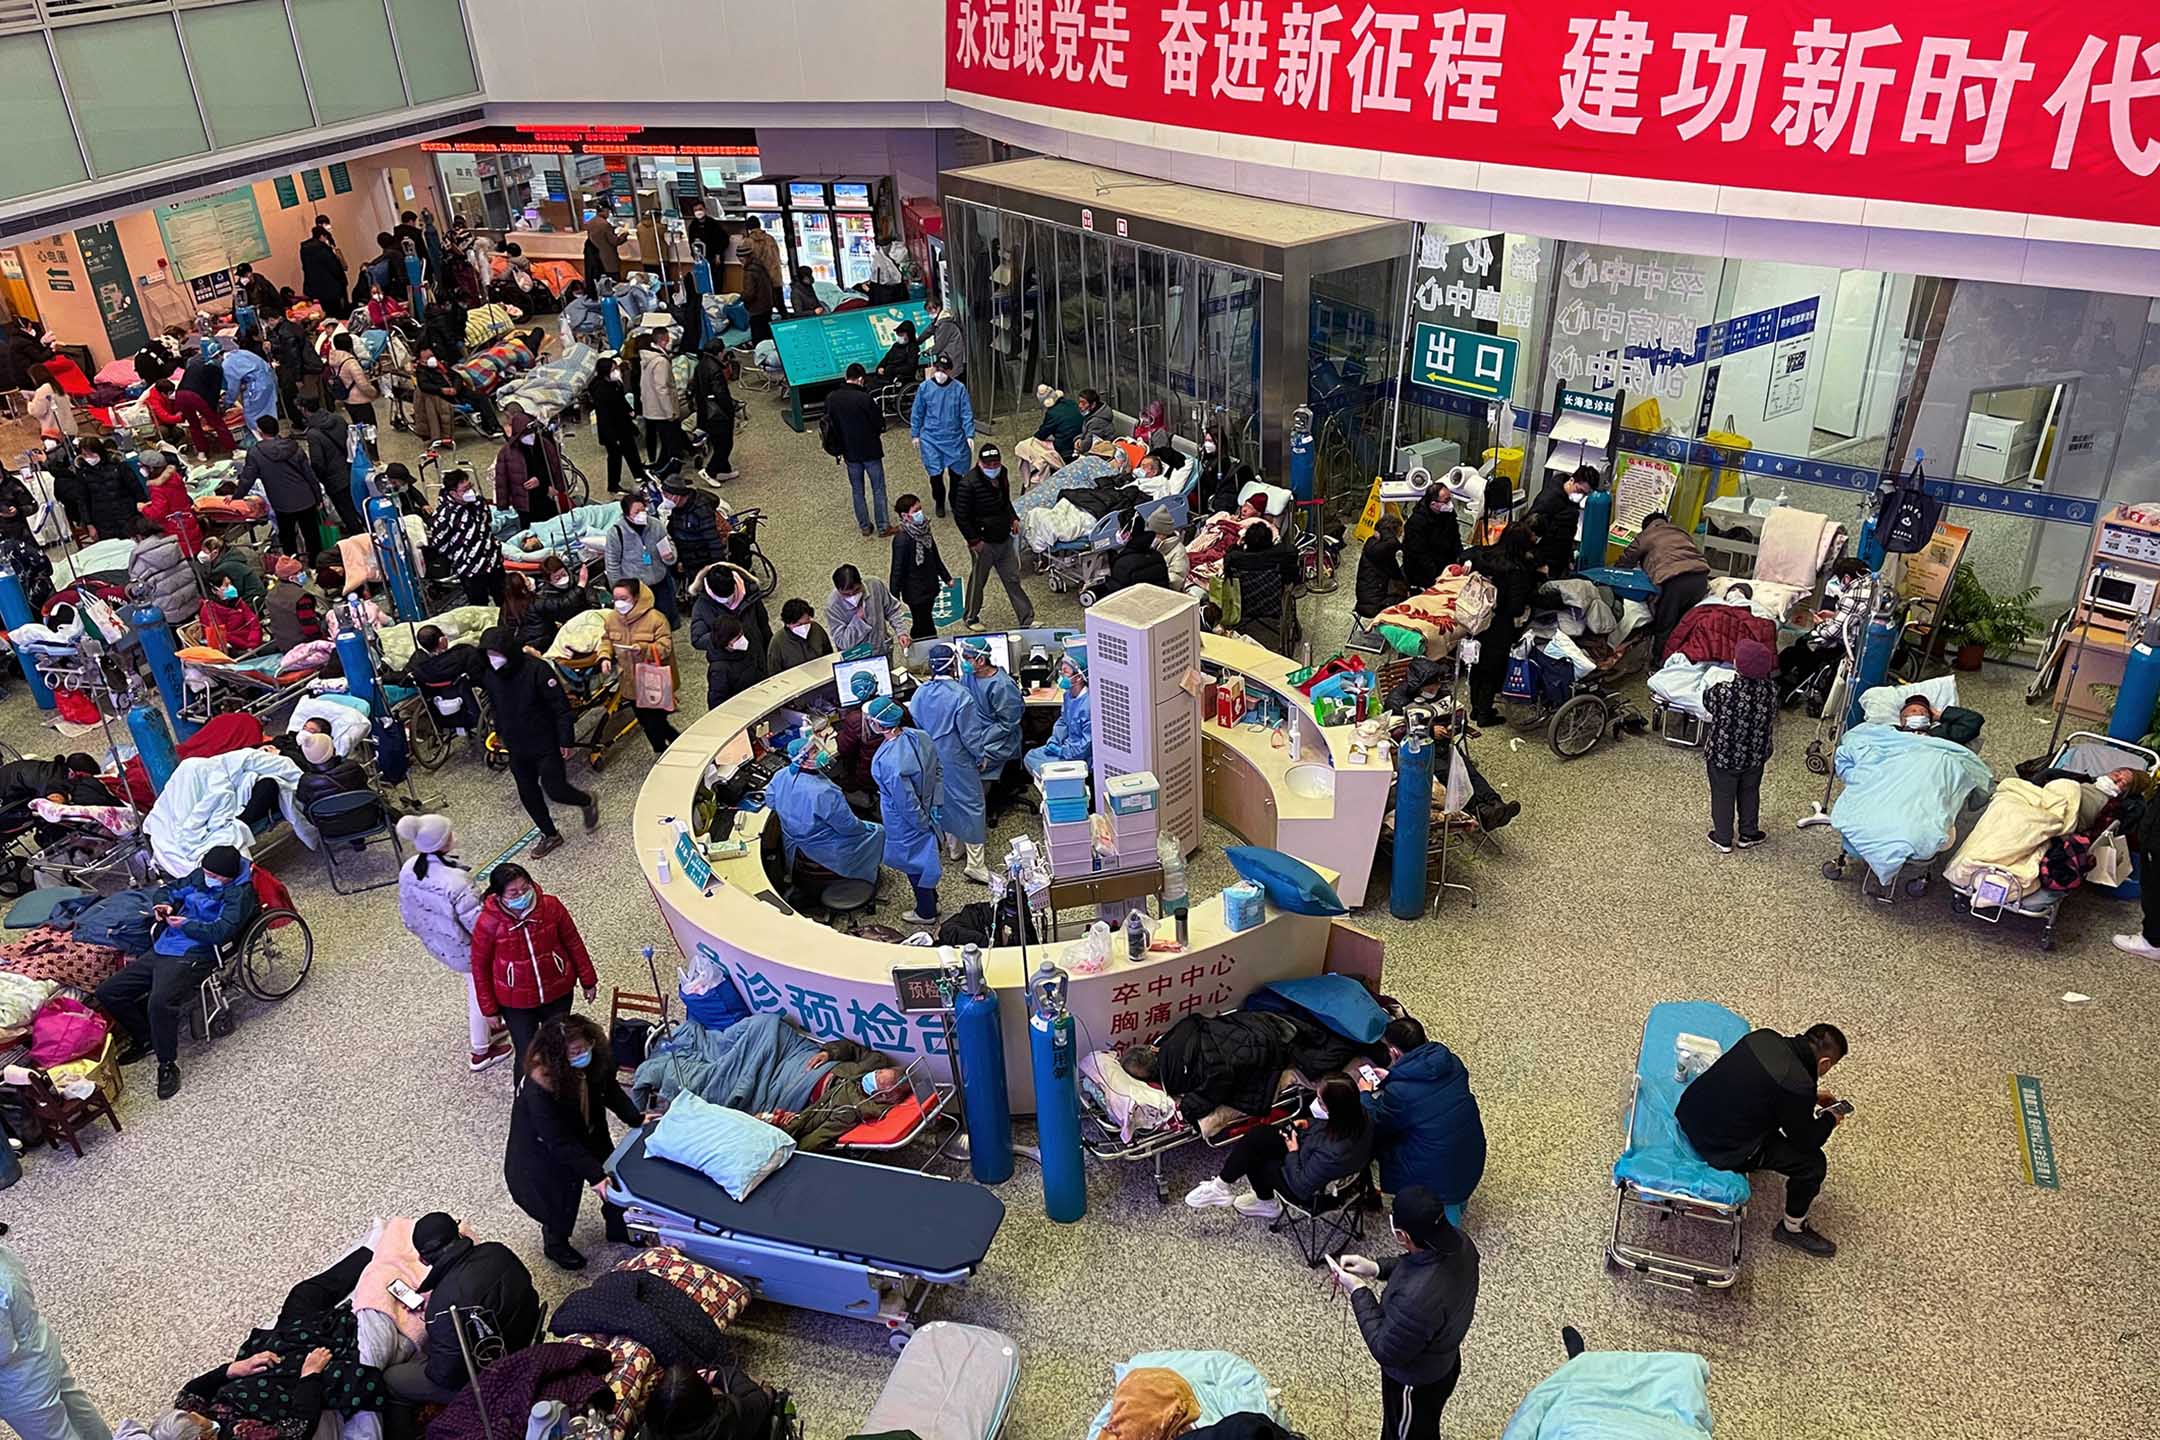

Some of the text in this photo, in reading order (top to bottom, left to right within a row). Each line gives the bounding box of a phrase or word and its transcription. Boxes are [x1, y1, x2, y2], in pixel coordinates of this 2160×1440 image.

[956, 0, 2160, 177] 永远跟党走 奋进新征程 建功新时代
[1425, 330, 1505, 383] 出口
[1563, 393, 1615, 413] 长海急诊科
[697, 942, 961, 1056] 诊预检台
[1111, 953, 1236, 1006] 卒中中心
[1110, 982, 1233, 1036] 胸痛中心
